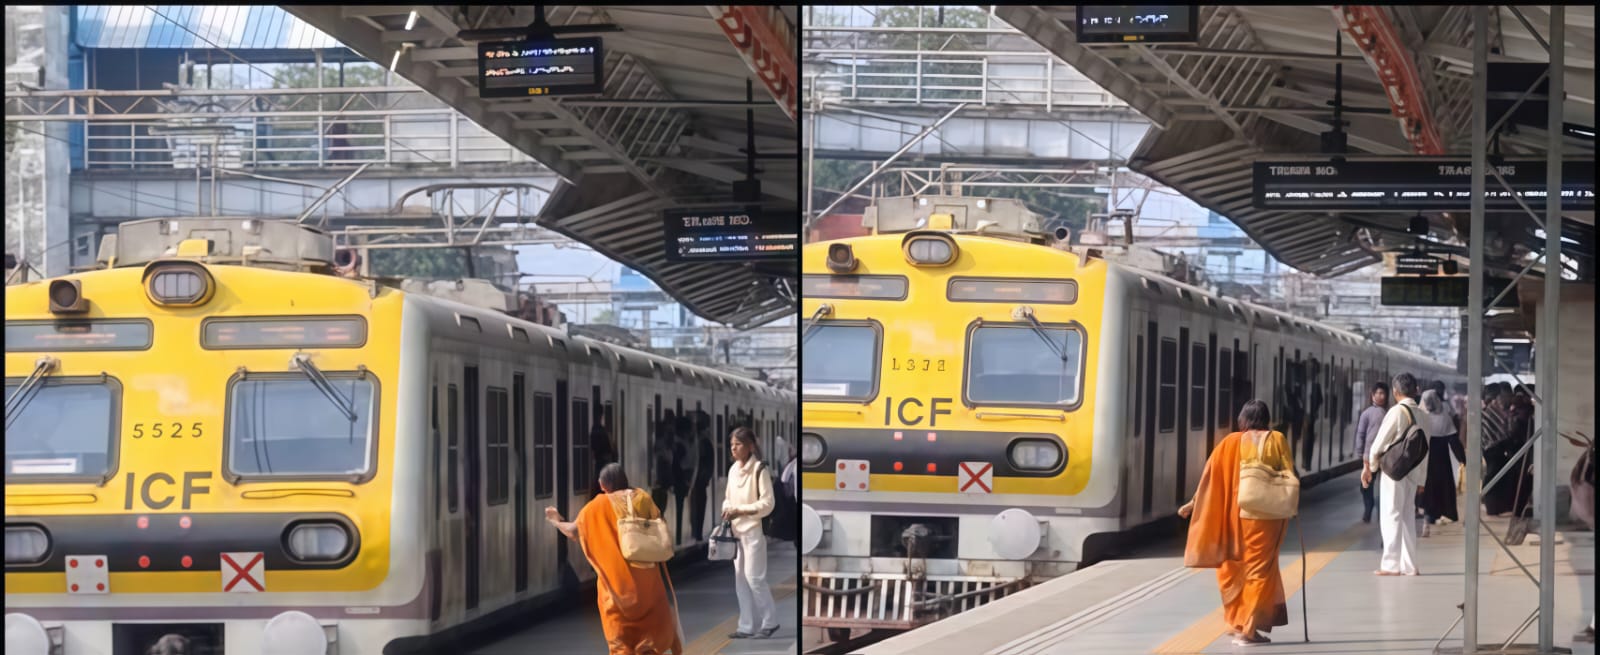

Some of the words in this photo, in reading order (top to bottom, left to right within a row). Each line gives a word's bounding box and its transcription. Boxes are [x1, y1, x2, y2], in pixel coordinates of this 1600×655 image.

[885, 397, 953, 426] ICF
[132, 422, 204, 439] 5525
[124, 471, 213, 510] ICF
